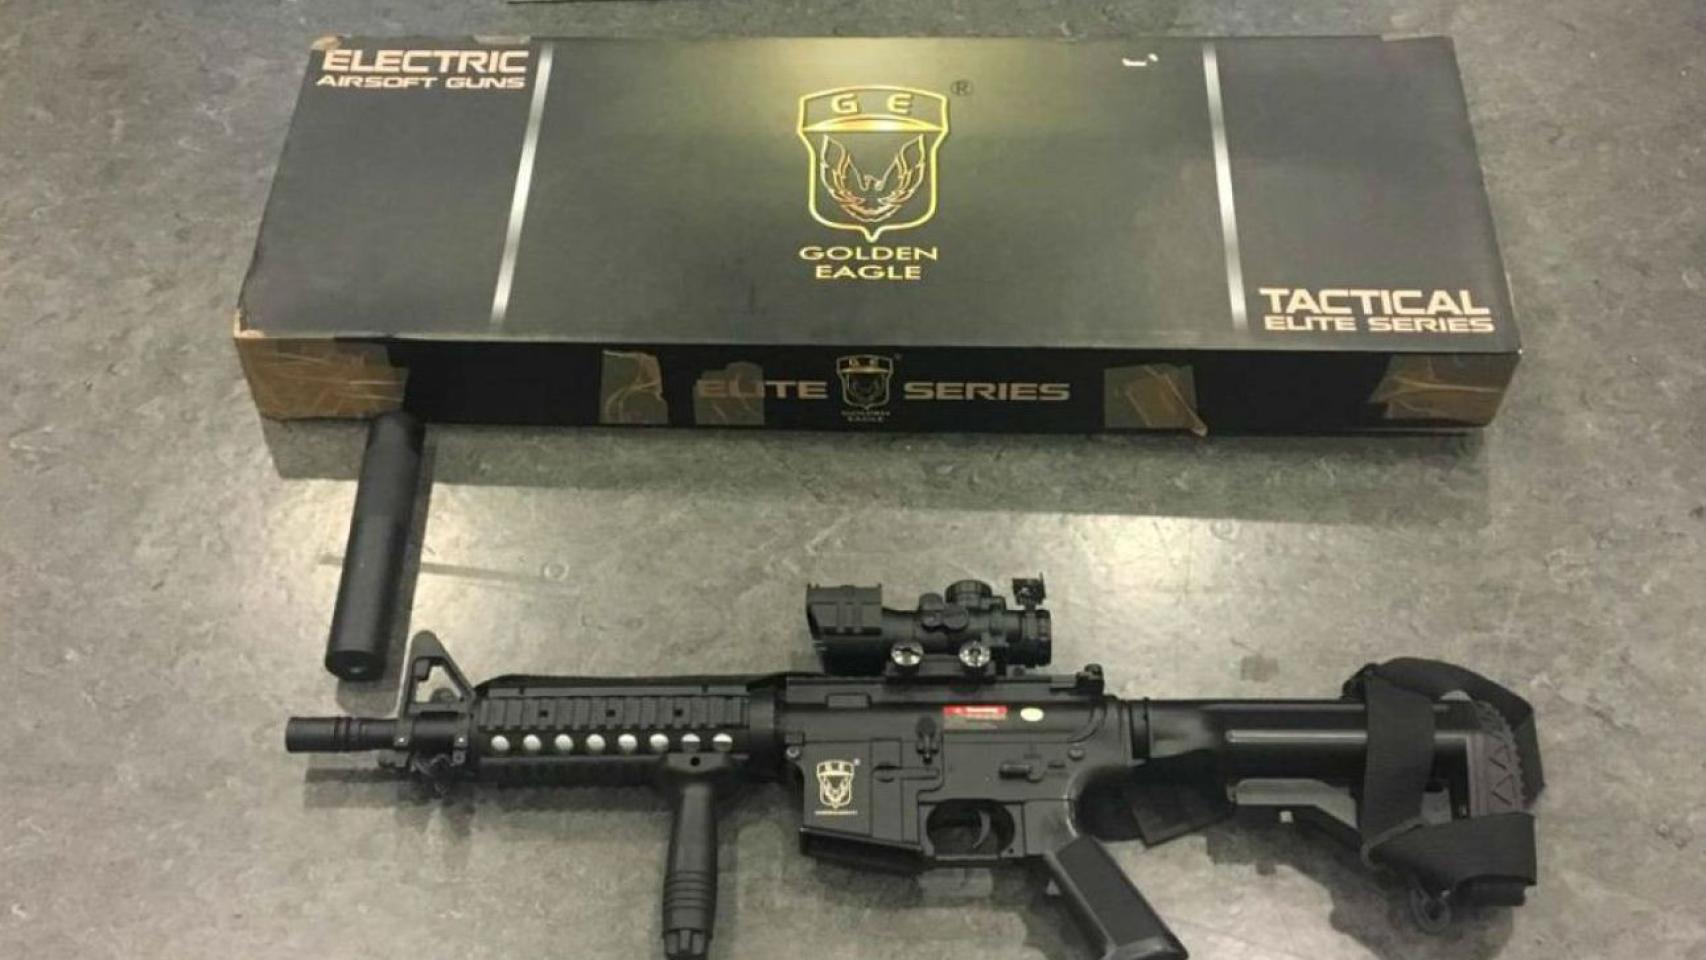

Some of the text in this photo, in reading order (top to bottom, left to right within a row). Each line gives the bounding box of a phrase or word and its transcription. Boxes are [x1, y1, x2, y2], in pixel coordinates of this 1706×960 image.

[322, 49, 529, 73] ELECTRIC
[316, 74, 525, 89] AIRSOFT GUNS
[799, 246, 938, 261] GOLDEN
[815, 265, 921, 280] EAGLE
[1258, 288, 1490, 315] TACTICAL
[1264, 316, 1495, 333] ELITE SERIES
[904, 382, 1071, 401] SERIES
